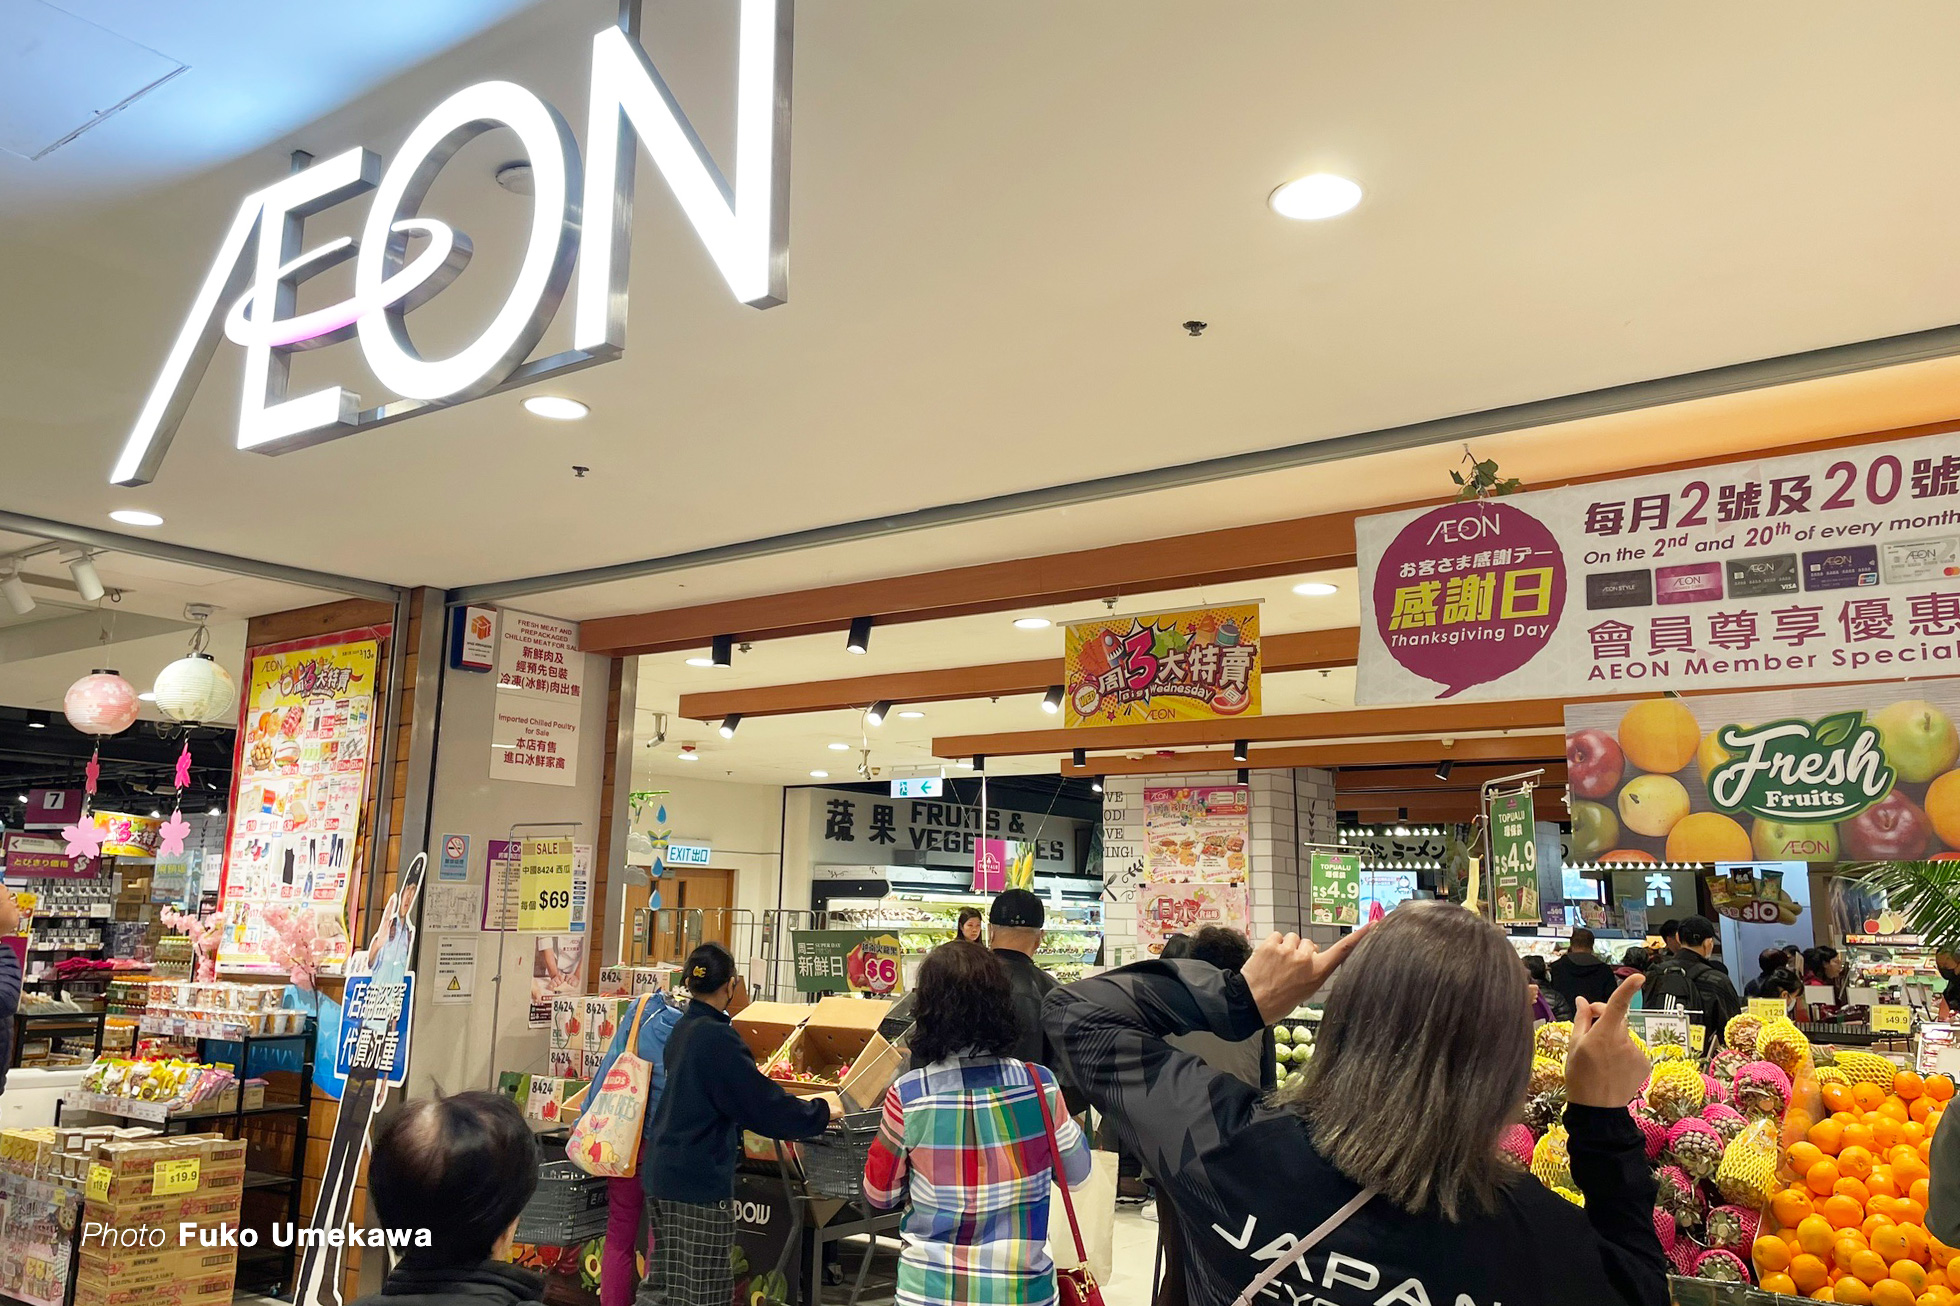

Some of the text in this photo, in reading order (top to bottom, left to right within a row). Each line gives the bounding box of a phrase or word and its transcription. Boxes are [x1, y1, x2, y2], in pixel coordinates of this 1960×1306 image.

[1584, 551, 1610, 565] On
[1616, 547, 1646, 562] the
[1694, 535, 1735, 553] and
[1794, 526, 1816, 542] of
[1820, 517, 1883, 540] every
[1889, 508, 1960, 532] month
[1399, 546, 1554, 578] お客さま感謝デー
[1388, 566, 1554, 631] 感謝日
[517, 619, 573, 636] FRESH MEAT AND
[520, 628, 569, 643] PREPACKAGED
[1391, 622, 1551, 648] Thanksgiving Day
[1586, 591, 1960, 661] 會員尊享優惠
[504, 632, 578, 652] CHILLED MEAT FOR SAL
[522, 646, 564, 665] 新鮮肉及
[515, 660, 569, 681] 經預先包裝
[1586, 659, 1671, 682] AEON
[1683, 653, 1818, 677] Member
[1077, 690, 1096, 708] WED
[1150, 682, 1214, 702] Wednesday
[498, 713, 577, 733] Imported Chilled Poultry
[525, 726, 550, 738] for Sale
[516, 737, 557, 755] 本店有售
[1712, 723, 1889, 808] Fresh
[49, 792, 61, 807] 7
[1104, 791, 1124, 803] VE
[1765, 789, 1845, 808] Fruits
[824, 798, 897, 845] 蔬果
[910, 801, 1026, 835] FRUITS &
[1104, 827, 1124, 840] VE
[536, 842, 558, 855] SALE
[908, 826, 1065, 862] VEGEES
[1392, 839, 1446, 860] ラーメン
[669, 846, 692, 862] EXIT
[691, 848, 709, 863] 出口
[538, 890, 570, 911] $69
[1742, 901, 1779, 921] $10
[797, 942, 816, 955] 周三
[797, 955, 844, 978] 新鮮日
[865, 957, 899, 985] $6
[601, 971, 622, 983] 8424
[635, 973, 658, 985] 8424
[553, 1000, 574, 1013] 8424
[586, 1002, 607, 1015] 8424
[1885, 1016, 1909, 1026] $49.9
[550, 1051, 571, 1064] 8424
[531, 1081, 553, 1095] 8424
[170, 1170, 198, 1184] $19.9
